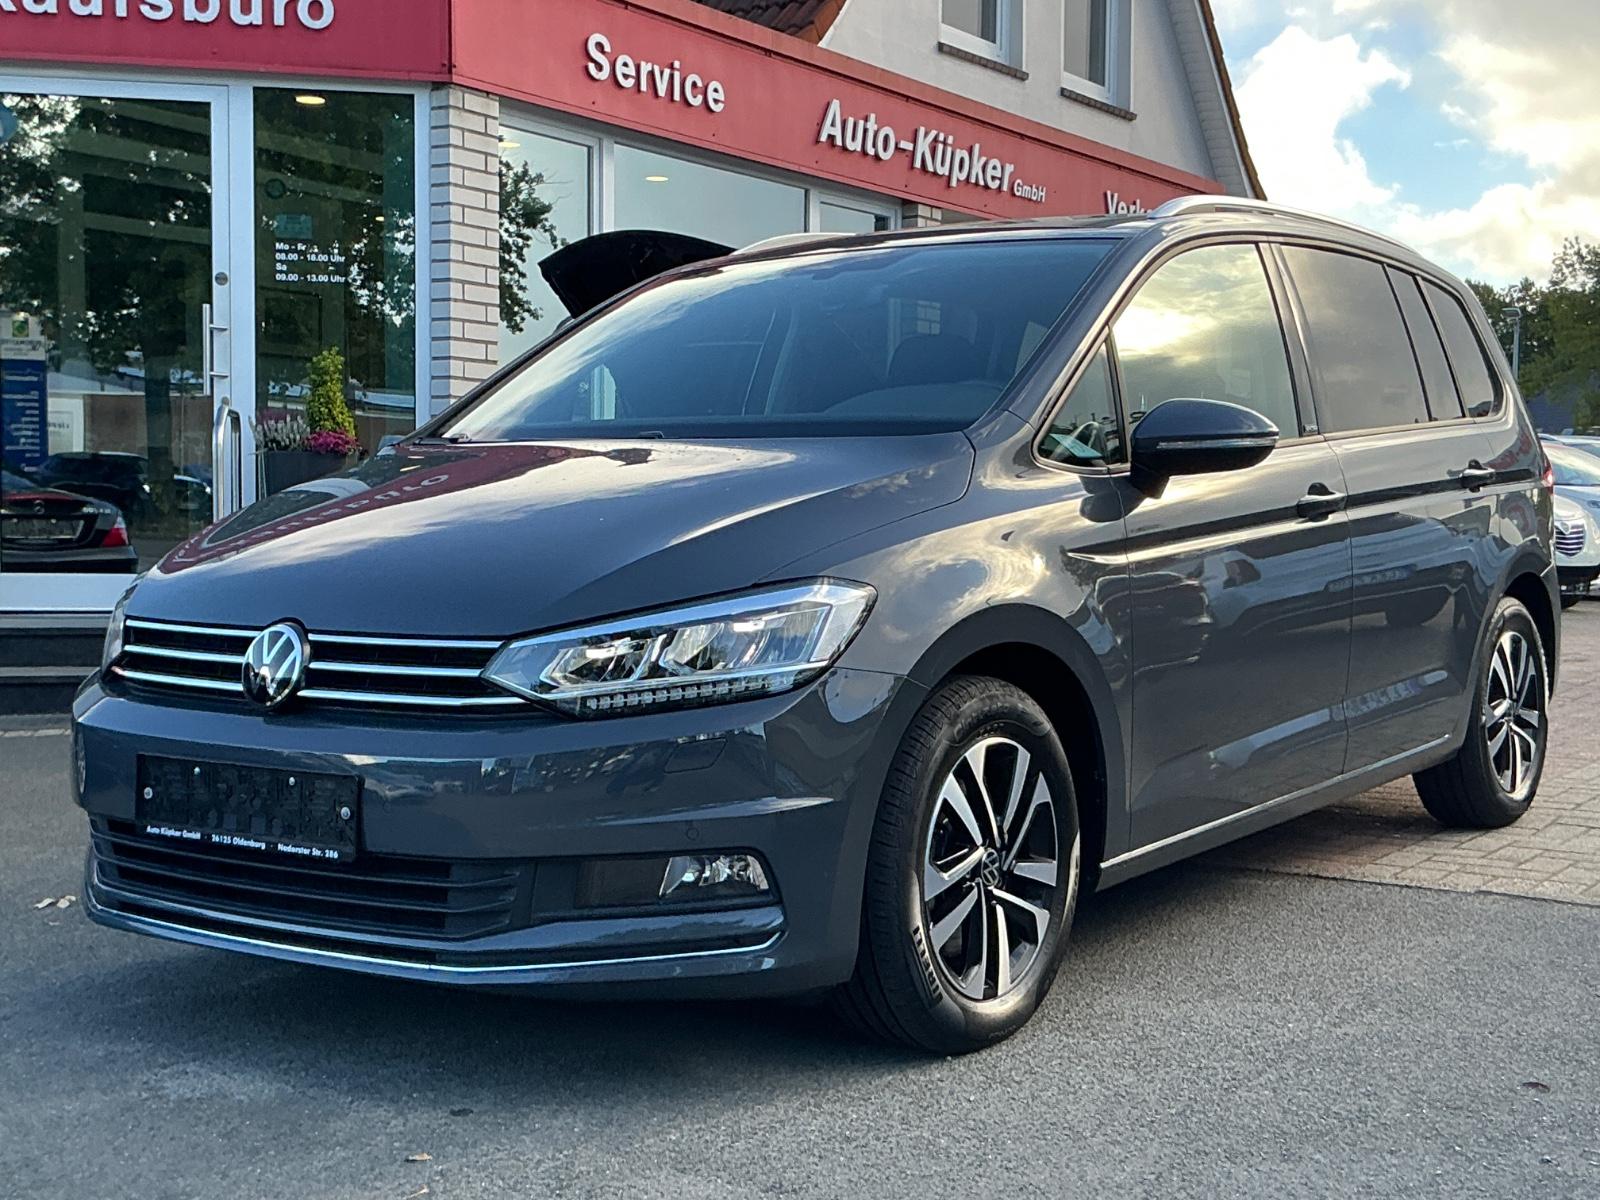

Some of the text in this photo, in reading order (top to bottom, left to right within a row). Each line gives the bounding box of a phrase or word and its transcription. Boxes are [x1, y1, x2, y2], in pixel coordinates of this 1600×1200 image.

[586, 32, 725, 113] Service
[819, 98, 1046, 202] Auto-Küpker GmbH
[275, 242, 289, 250] Mo
[297, 243, 306, 251] Fr
[275, 252, 298, 261] 08.00
[306, 253, 328, 262] 18.00
[330, 254, 345, 262] Uhr
[275, 262, 287, 271] Sa
[275, 273, 299, 281] 09.00
[306, 274, 328, 282] 13.00
[330, 274, 345, 283] Uhr
[211, 834, 231, 844] 26125
[232, 837, 266, 850] Oldenburg
[311, 847, 323, 857] Str.
[325, 849, 339, 859] 286
